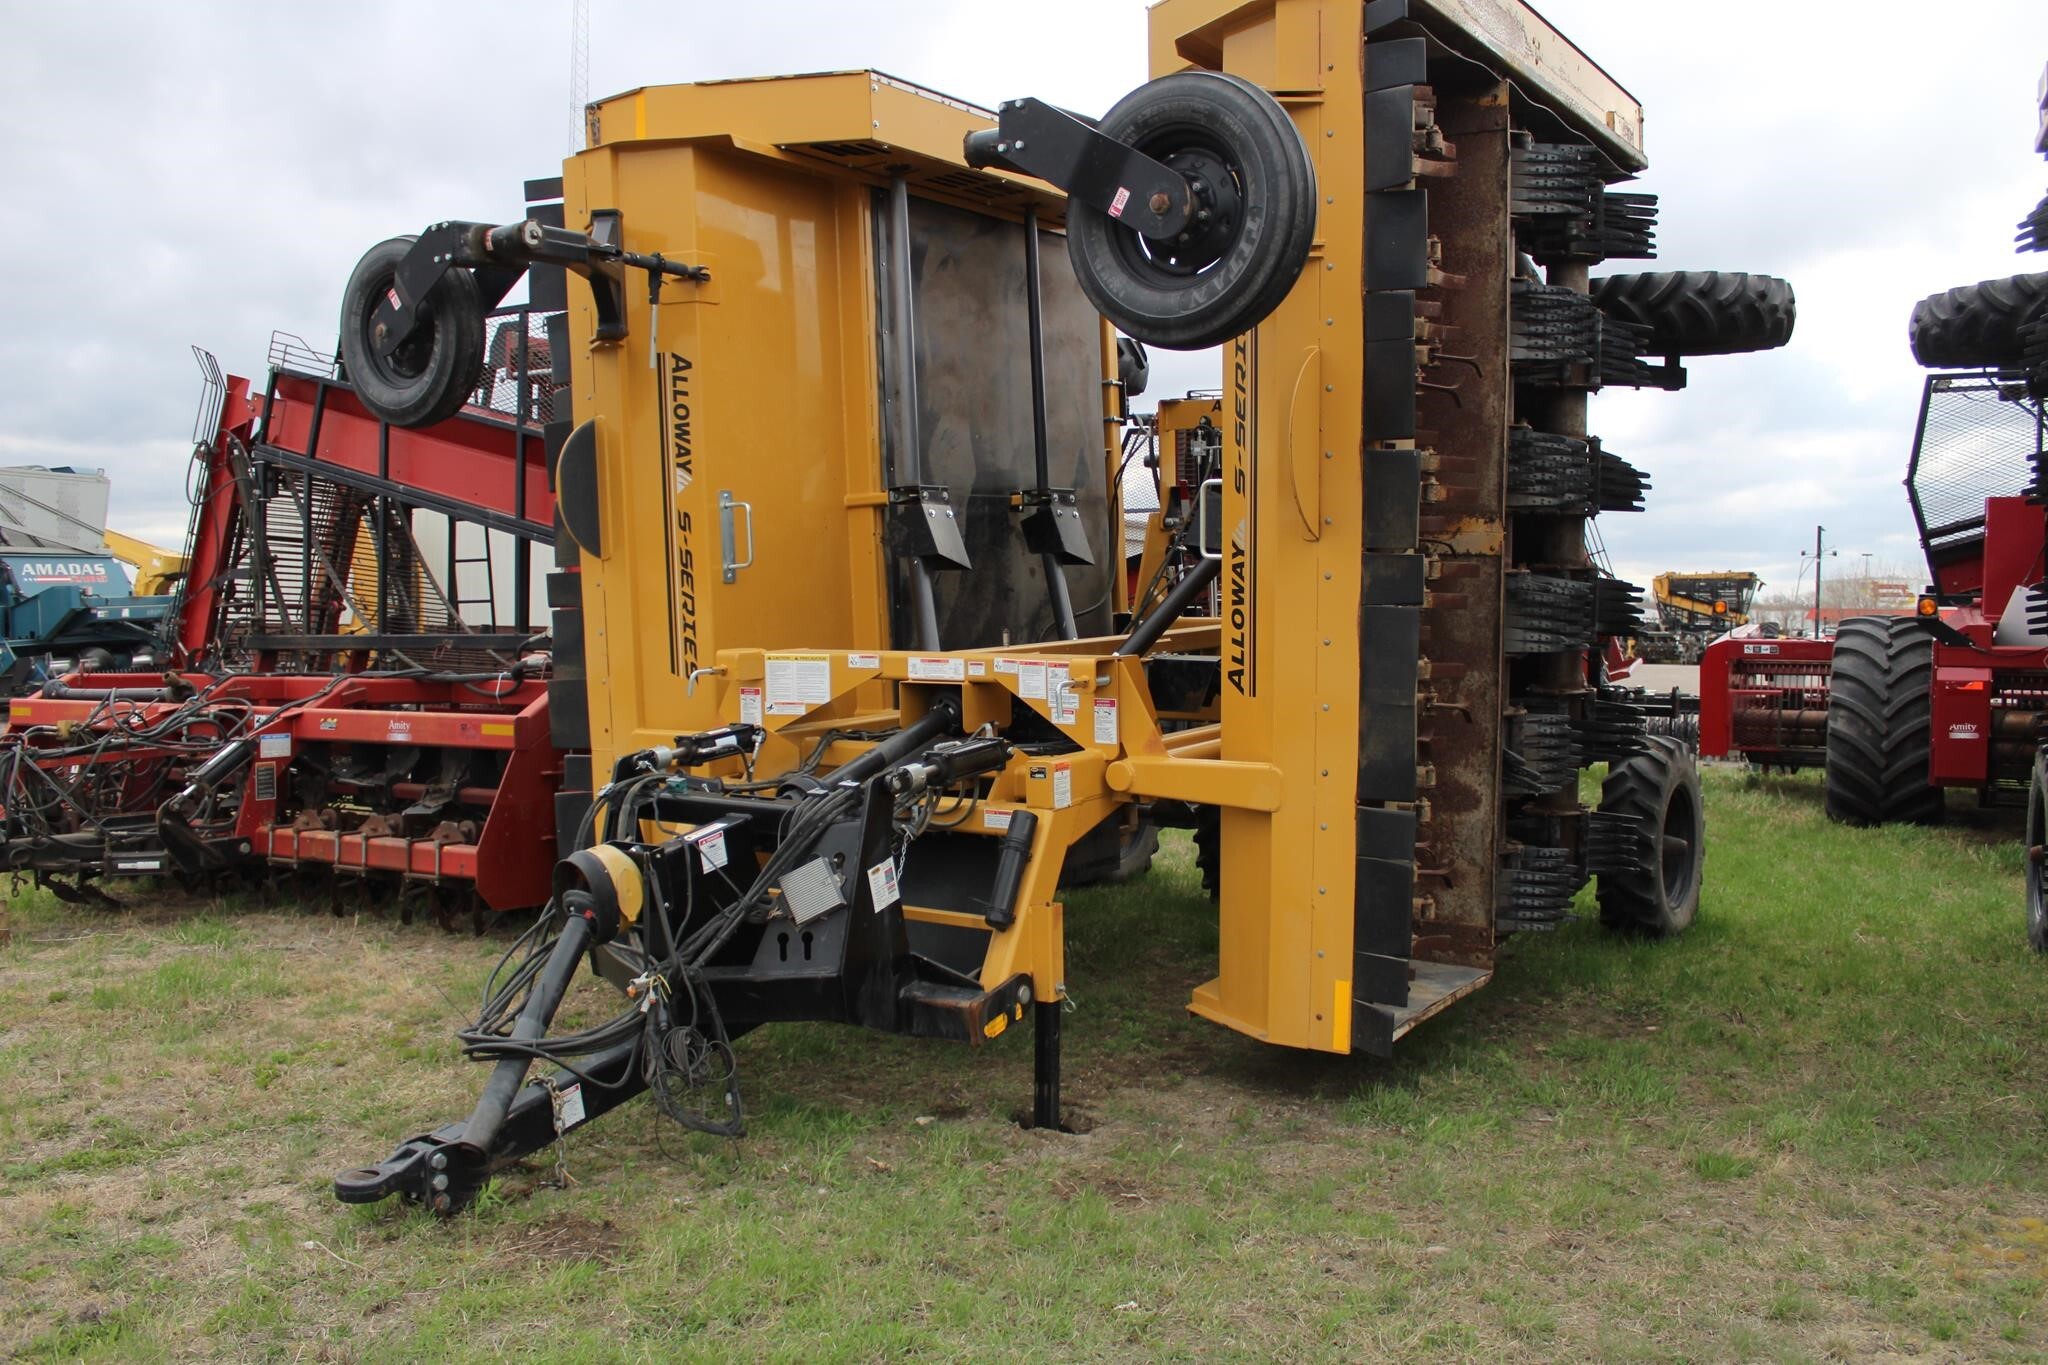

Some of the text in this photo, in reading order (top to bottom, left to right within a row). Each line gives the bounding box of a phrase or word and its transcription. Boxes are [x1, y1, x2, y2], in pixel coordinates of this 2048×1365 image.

[671, 352, 698, 685] ALLOWAY S-SERIES
[1227, 332, 1246, 696] ALLOWAY S-SERI
[22, 563, 106, 576] AMADAS
[388, 719, 411, 731] Amity
[1949, 723, 1977, 732] Amity
